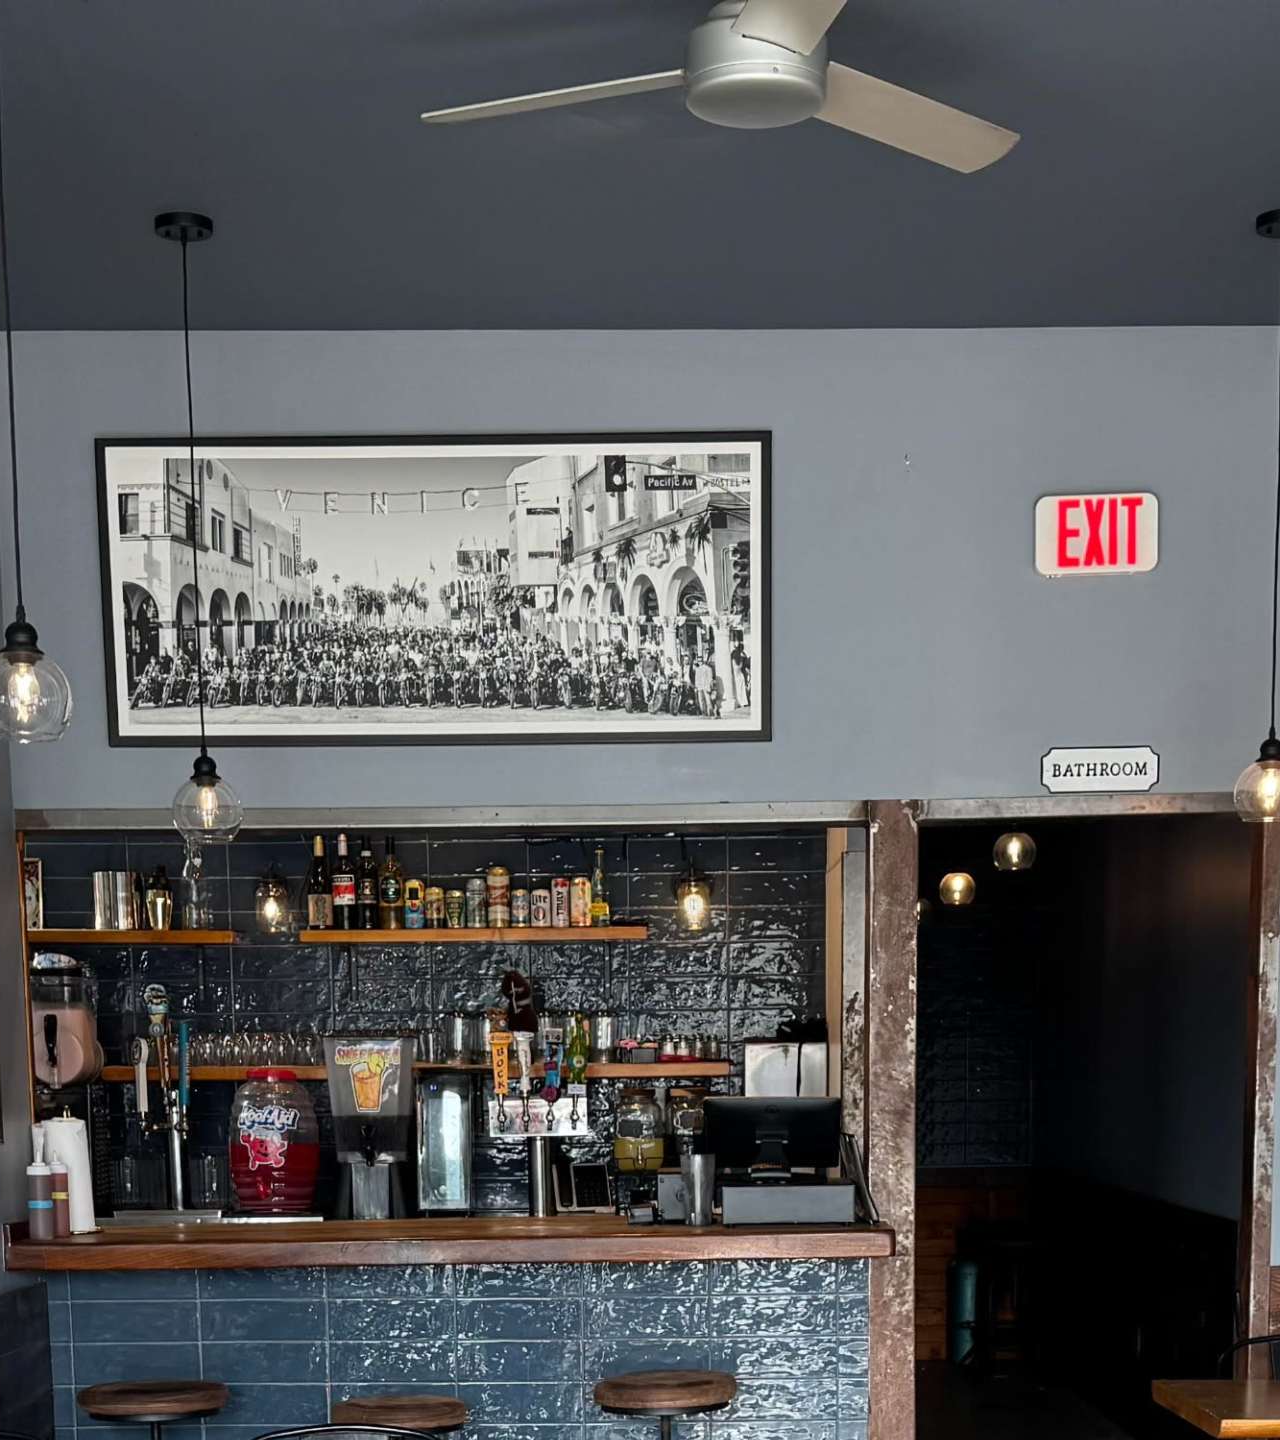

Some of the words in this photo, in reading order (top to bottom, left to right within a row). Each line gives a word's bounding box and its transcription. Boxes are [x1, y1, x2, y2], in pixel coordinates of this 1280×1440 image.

[274, 482, 530, 517] VENICE
[1058, 496, 1144, 568] EXIT
[1052, 760, 1148, 778] BATHROOM
[496, 1047, 506, 1089] BOCK
[238, 1102, 299, 1131] Kool-Aid
